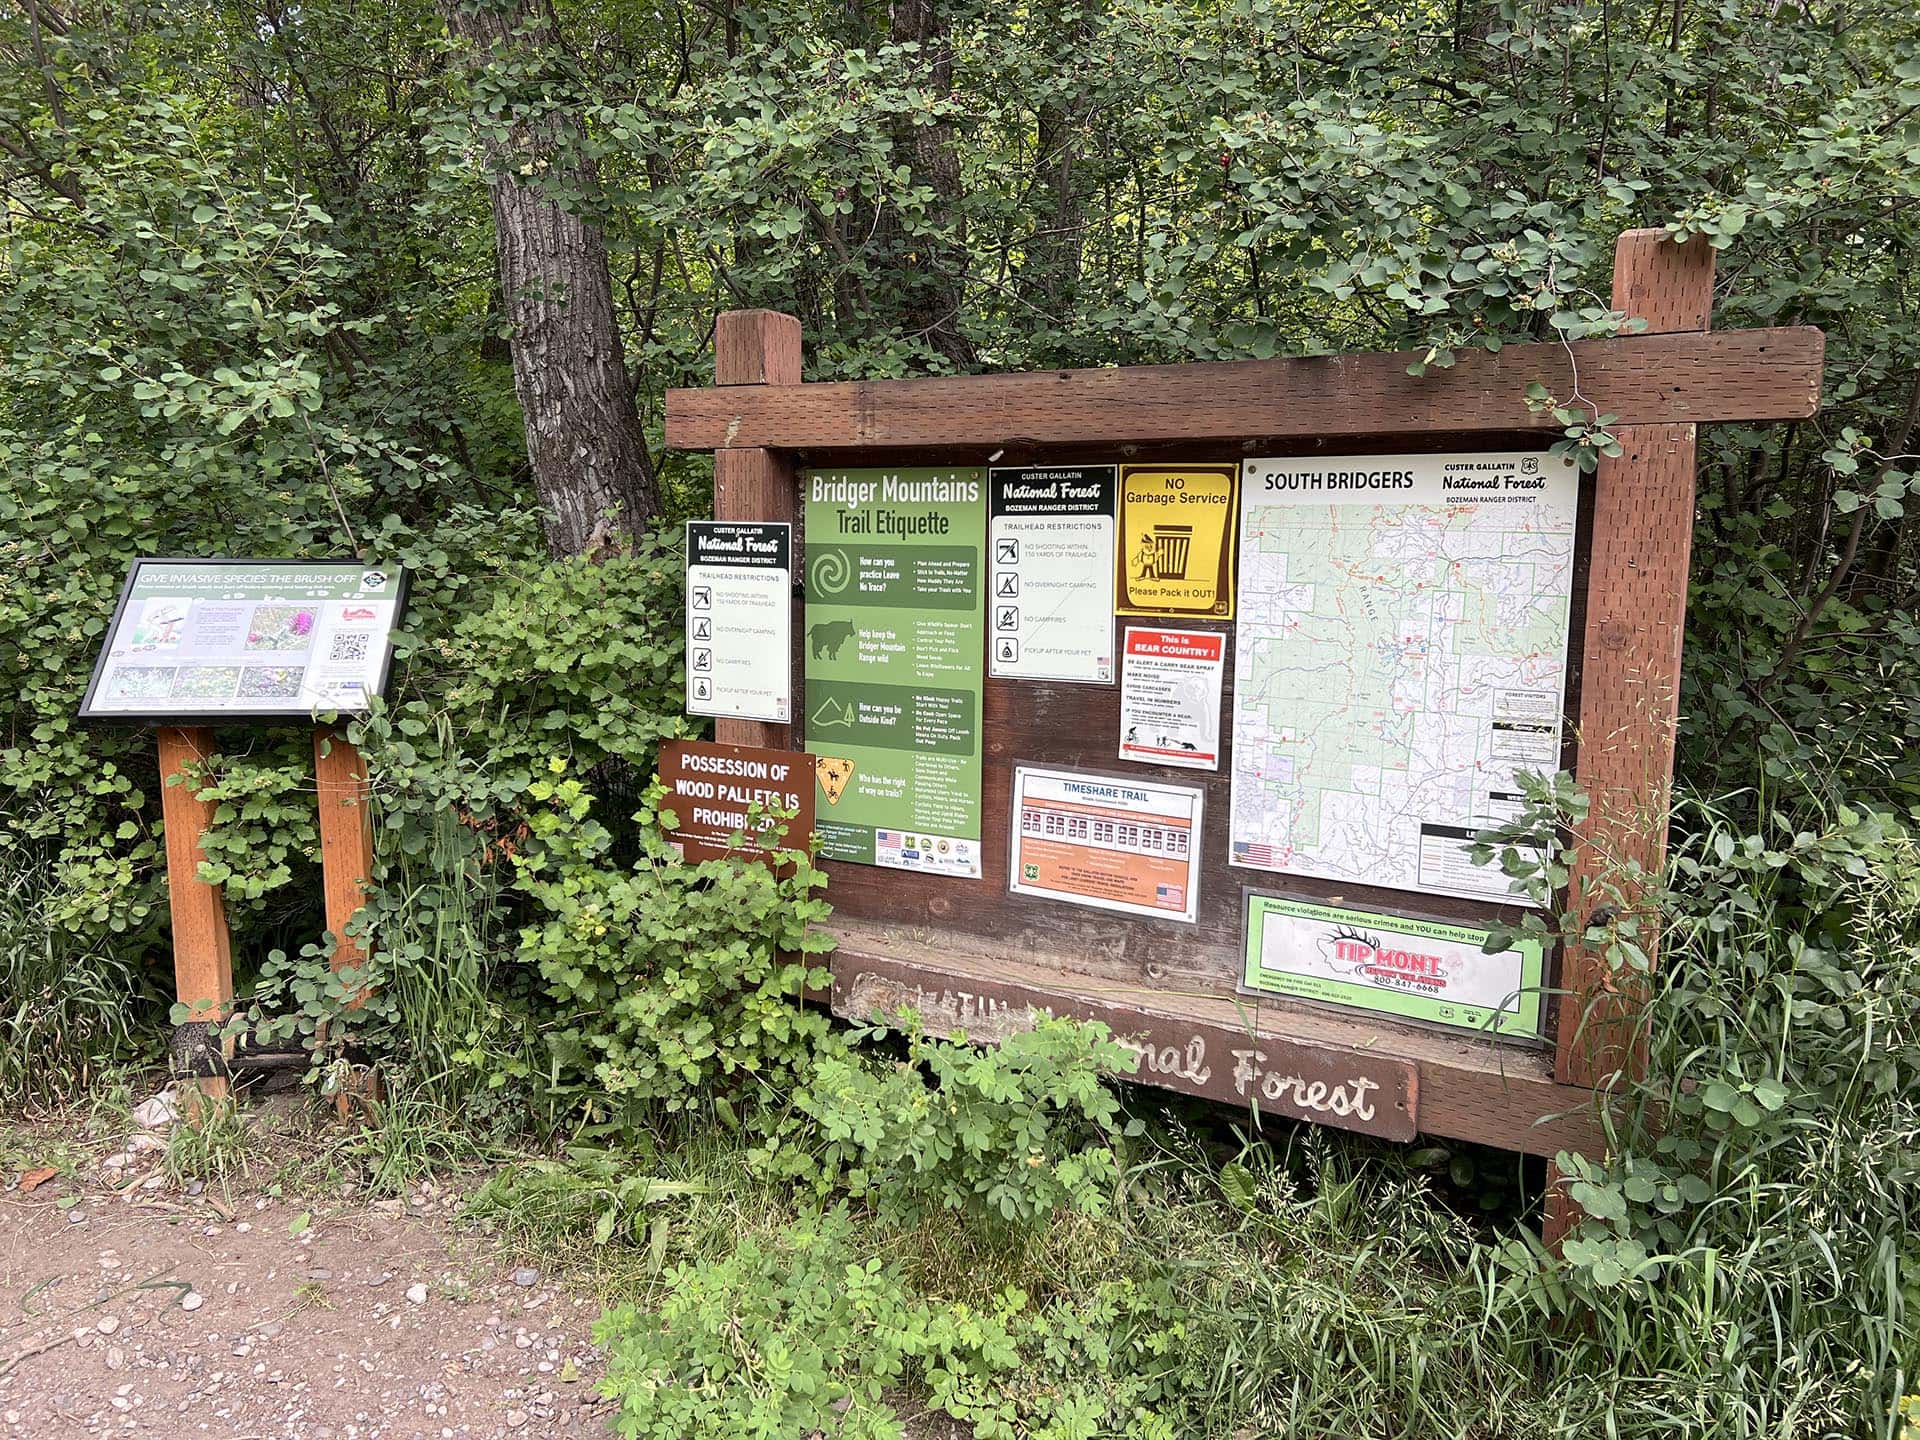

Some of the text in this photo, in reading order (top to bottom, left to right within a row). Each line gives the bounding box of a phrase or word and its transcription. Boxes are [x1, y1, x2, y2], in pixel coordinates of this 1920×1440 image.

[1049, 472, 1082, 480] GALLATIN
[1265, 471, 1414, 490] SOUTH BRIDGERS
[1165, 478, 1185, 489] NO
[1443, 475, 1547, 490] National Forest
[812, 474, 979, 509] Bridger Mountains
[1003, 482, 1101, 499] National Forest
[1126, 492, 1227, 506] Garbage Service
[1005, 504, 1038, 512] BOZEMAN
[837, 510, 949, 541] Trail Etiquette
[698, 536, 779, 553] National Forest
[860, 557, 872, 566] How
[884, 559, 895, 568] you
[140, 574, 357, 583] GIVE INVASIVE SPECIES THE BRUSH OFF
[699, 572, 779, 582] TRAILHEAD RESTRICTIONS
[860, 570, 900, 580] practice Leave
[859, 582, 887, 592] No Trace?
[1129, 587, 1215, 598] Please Pack it OUT!
[1360, 586, 1379, 623] RANGE
[859, 629, 896, 640] Help keep the
[1160, 635, 1180, 644] This
[859, 641, 906, 652] Bridger Mountain
[1135, 644, 1160, 653] BEAR
[1162, 646, 1209, 656] COUNTRY
[859, 653, 889, 664] Range wild
[859, 703, 871, 711] How
[884, 706, 894, 715] you
[895, 705, 901, 714] be
[859, 714, 896, 725] Outside Kind?
[681, 754, 789, 781] POSSESSION OF
[858, 773, 906, 788] Who has the right
[676, 779, 800, 809] WOOD PALLETS IS
[858, 786, 865, 794] of
[865, 788, 875, 796] way
[885, 789, 903, 798] trails?
[1063, 783, 1118, 798] TIMESHARE
[1121, 790, 1149, 802] TRAIL
[693, 807, 776, 833] PROHIBIED
[1264, 901, 1295, 912] Resource
[1297, 906, 1331, 918] violations
[1346, 914, 1372, 924] serious
[1373, 919, 1398, 928] crimes
[1400, 922, 1414, 930] and
[1416, 925, 1432, 933] YOU
[1449, 930, 1465, 939] help
[1467, 933, 1484, 942] stop
[1335, 940, 1441, 974] TIP MONT
[1231, 1049, 1380, 1122] Forest
